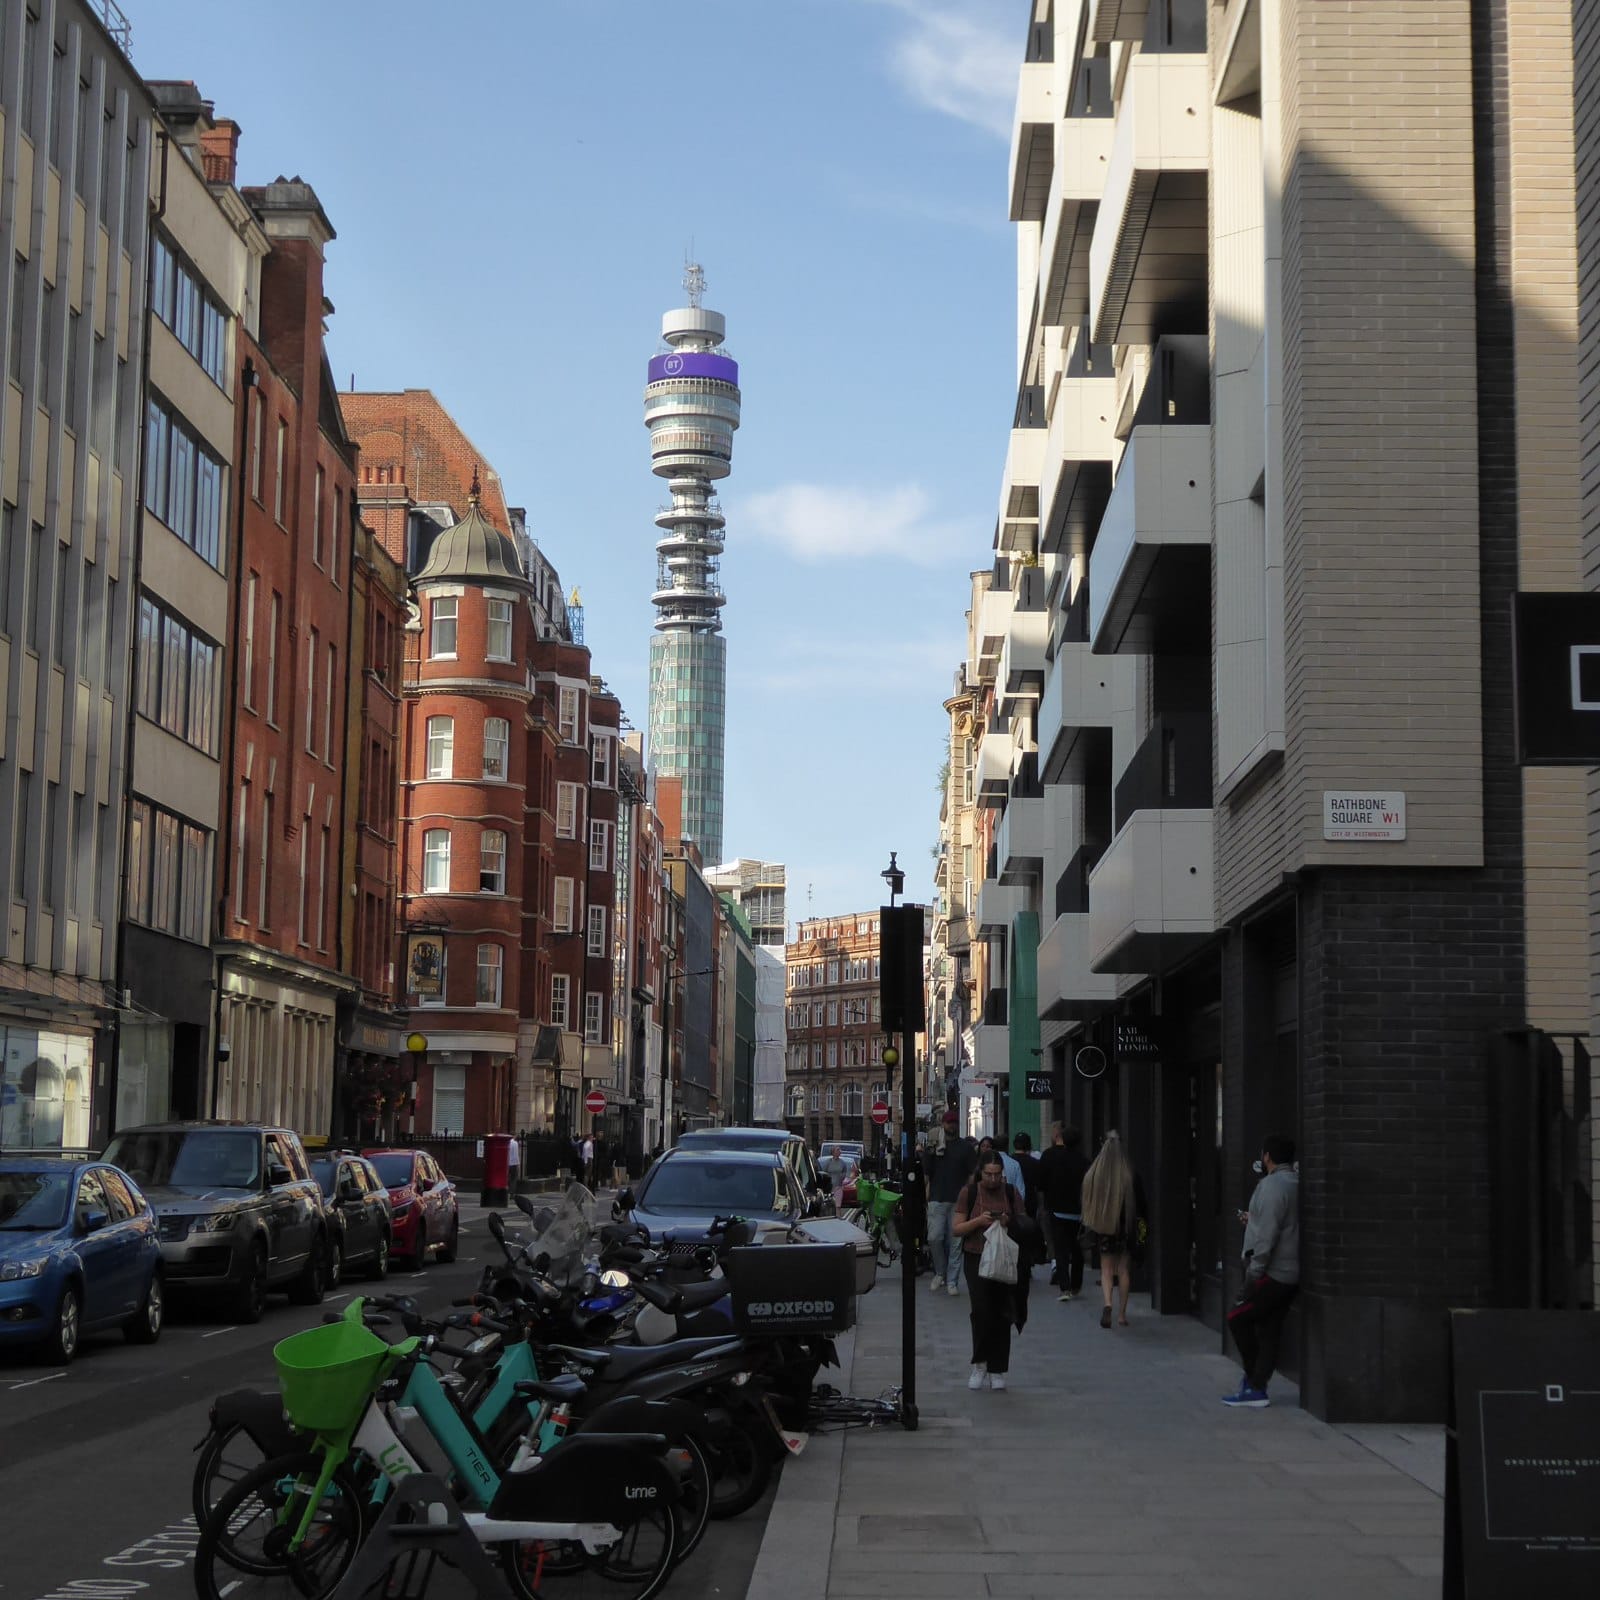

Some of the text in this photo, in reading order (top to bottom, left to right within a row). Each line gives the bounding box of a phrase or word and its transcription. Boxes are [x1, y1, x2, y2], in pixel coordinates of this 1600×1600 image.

[667, 360, 679, 370] BT
[1331, 799, 1387, 810] RATHBONE
[1331, 812, 1399, 824] SQUARE W1
[1118, 1043, 1159, 1052] LONDON
[773, 1301, 835, 1315] OXFORD
[466, 1447, 491, 1486] TIER
[625, 1485, 657, 1499] Lime
